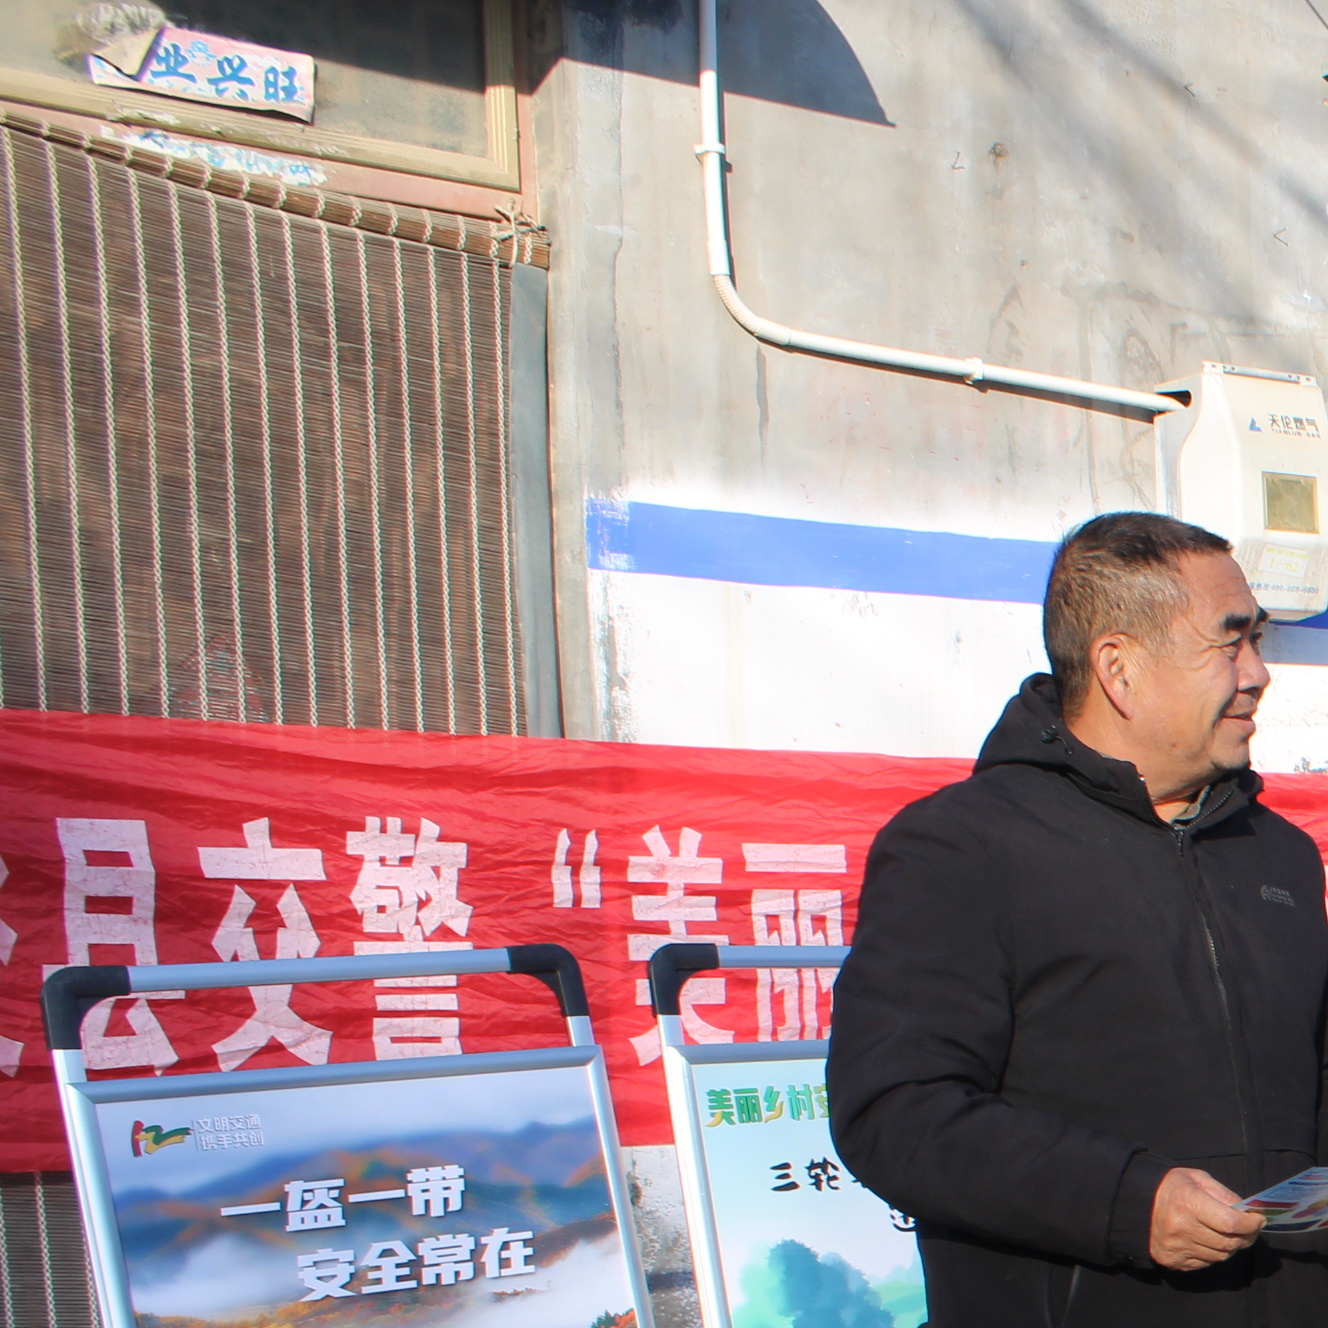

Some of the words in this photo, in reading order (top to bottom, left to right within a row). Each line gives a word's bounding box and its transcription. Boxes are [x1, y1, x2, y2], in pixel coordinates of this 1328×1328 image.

[197, 1113, 262, 1132] 文明交通
[200, 1131, 265, 1152] 携手共创
[220, 1164, 466, 1232] 一盔一带
[297, 1227, 536, 1302] 安全常在
